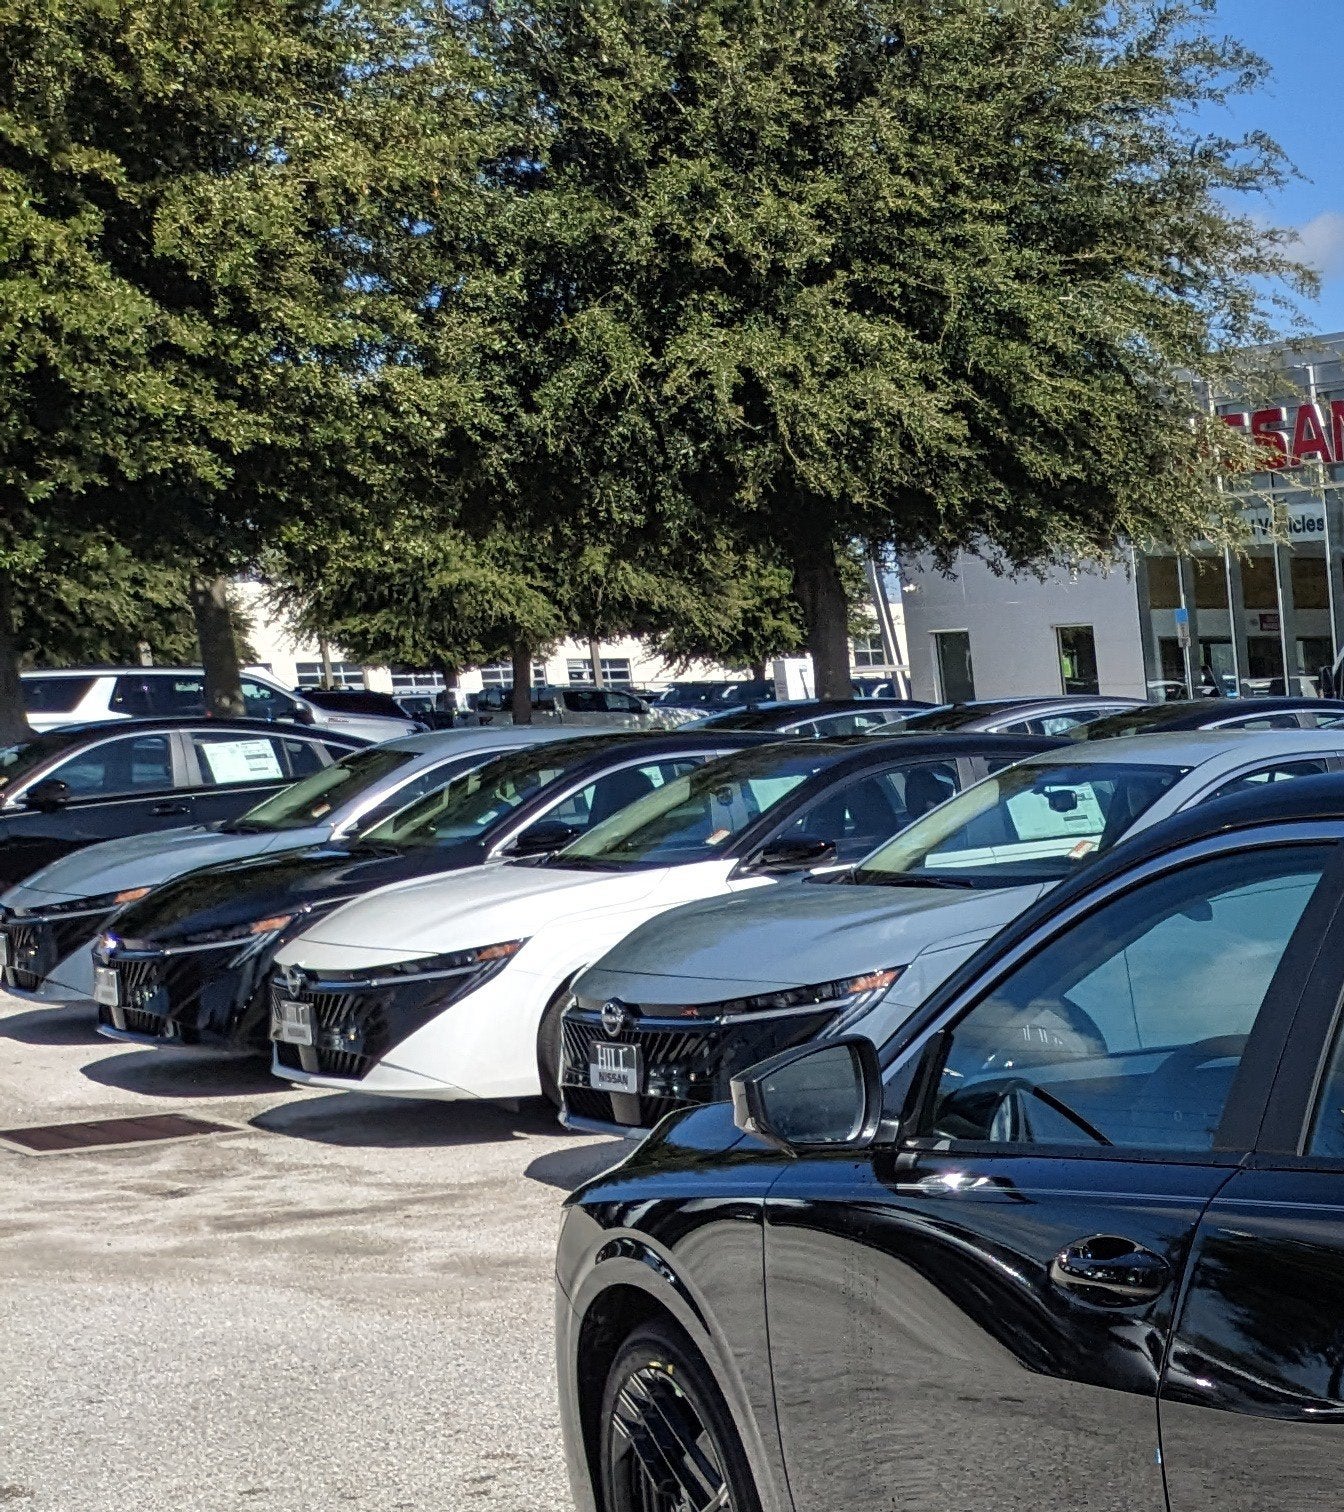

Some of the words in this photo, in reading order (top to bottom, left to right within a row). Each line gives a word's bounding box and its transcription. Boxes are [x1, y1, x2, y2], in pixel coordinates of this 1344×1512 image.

[1258, 515, 1325, 536] Vicles
[597, 1046, 628, 1072] HILL
[598, 1072, 628, 1085] NISSAN
